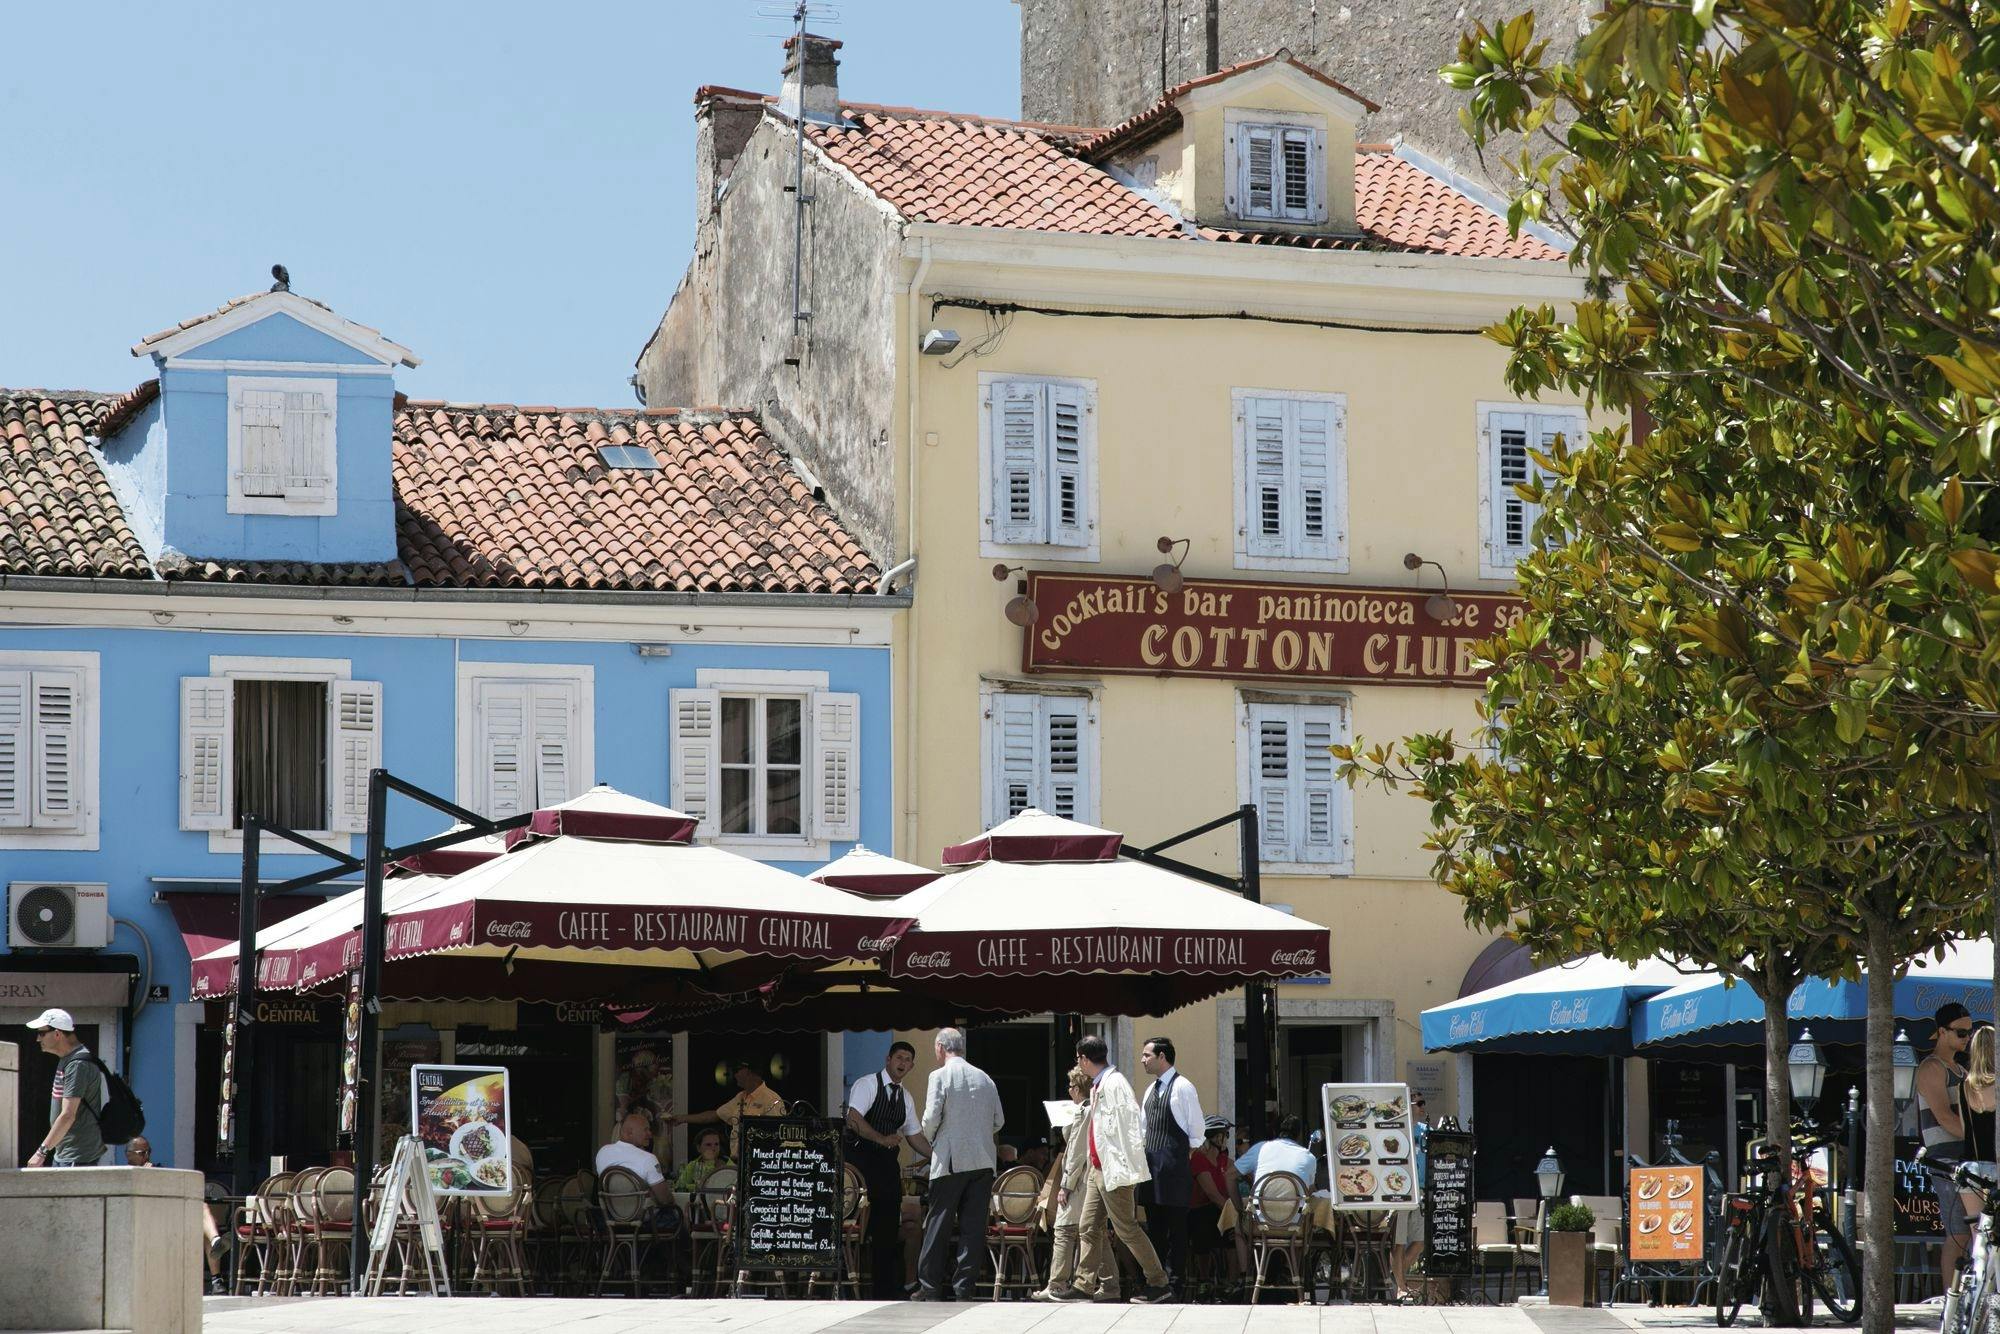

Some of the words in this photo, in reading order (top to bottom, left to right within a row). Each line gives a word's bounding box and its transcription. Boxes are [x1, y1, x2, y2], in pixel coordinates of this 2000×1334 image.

[1041, 585, 1169, 650] cocktail's
[1183, 588, 1233, 617] bar
[1257, 594, 1415, 624] paninoteca
[1440, 602, 1480, 627] ce
[1141, 624, 1335, 672] COTTON
[1363, 633, 1479, 677] CLUB
[399, 919, 424, 949] CENTRAL
[486, 919, 532, 938] Coca-Cola
[558, 911, 610, 941] CAFFE
[634, 912, 749, 943] RESTAURANT
[758, 917, 832, 950] CENTRAL
[906, 950, 952, 968] Coca-Cola
[977, 938, 1028, 967] CAFFE
[1051, 935, 1164, 965] RESTAURANT
[1174, 937, 1247, 965] CENTRAL
[1271, 949, 1317, 966] Coca-Cola
[153, 986, 162, 997] 4
[257, 1003, 320, 1023] CENTRAL
[556, 1003, 603, 1022] CENTR
[419, 1072, 444, 1087] CENTRAL
[779, 1123, 807, 1141] CENTRAL
[752, 1148, 774, 1159] Mixed
[775, 1149, 790, 1161] grill
[750, 1175, 779, 1187] Calamari
